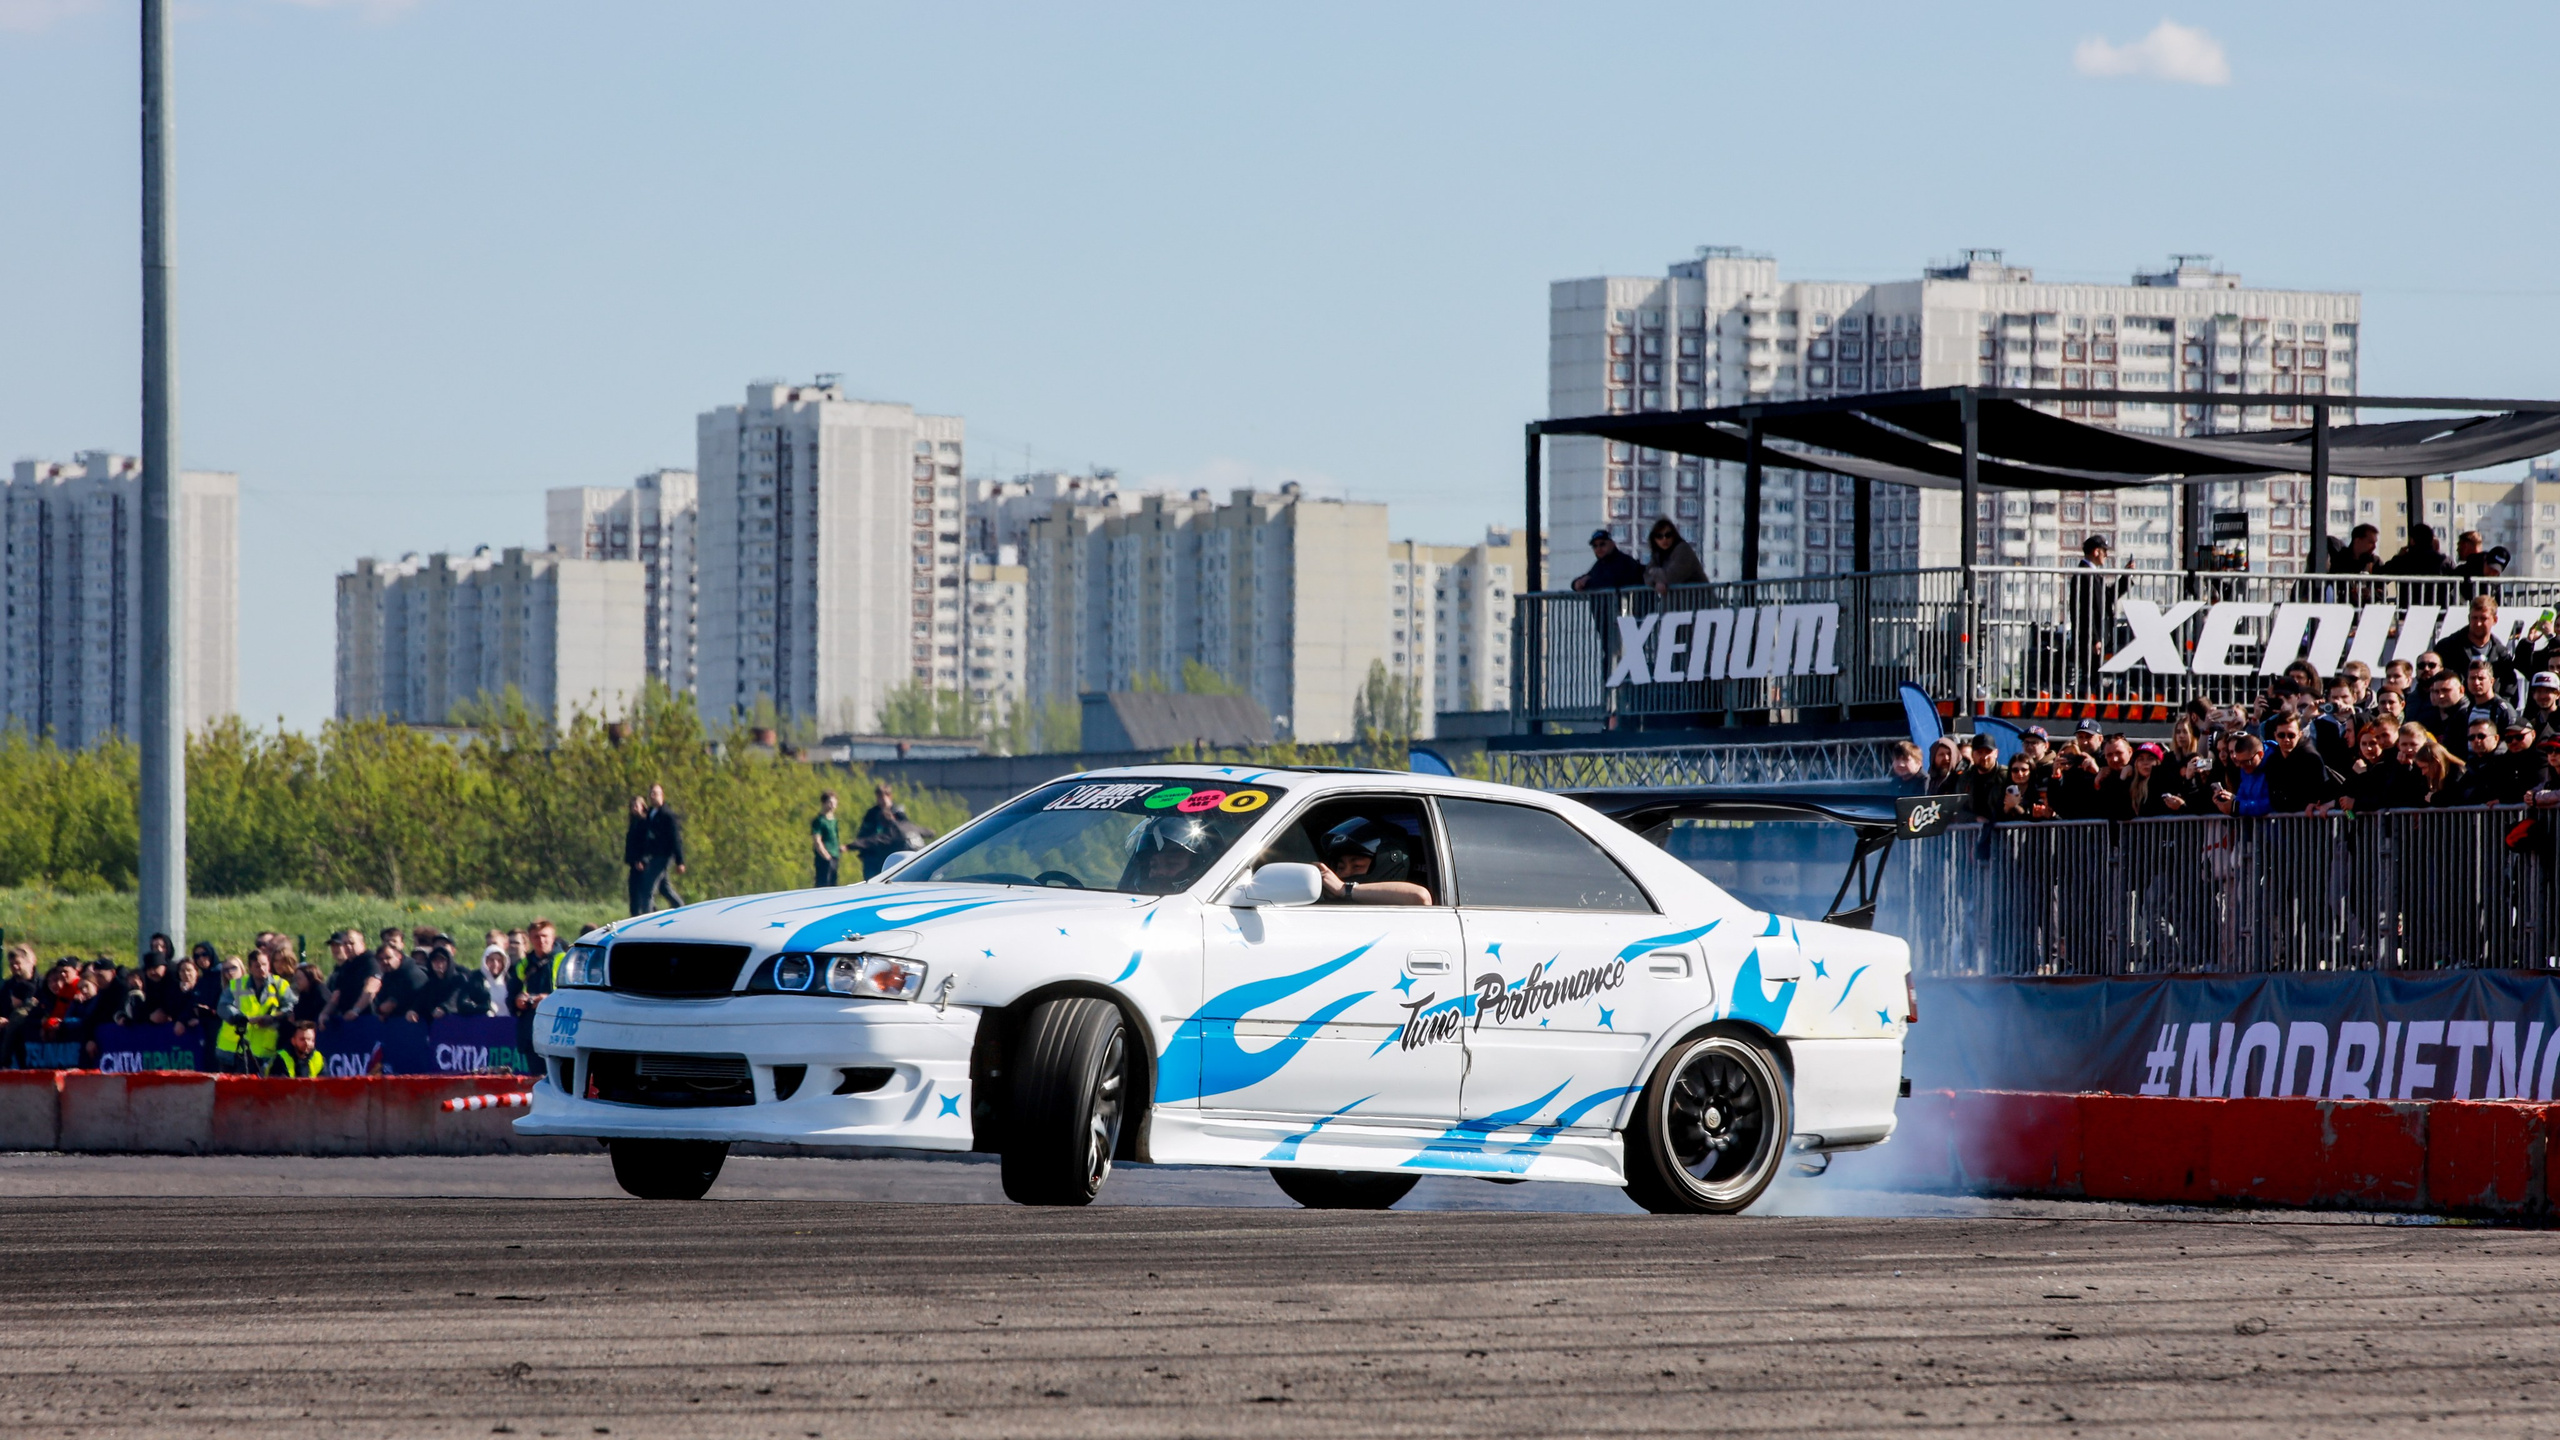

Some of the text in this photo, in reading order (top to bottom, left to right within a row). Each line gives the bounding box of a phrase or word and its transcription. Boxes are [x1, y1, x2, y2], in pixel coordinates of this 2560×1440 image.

[1605, 602, 1839, 687] XENUM
[1099, 783, 1163, 797] DRIFT
[1088, 795, 1135, 809] FEST
[1187, 794, 1221, 803] KISS
[1187, 800, 1212, 808] ME
[1399, 959, 1626, 1052] Tune Performance
